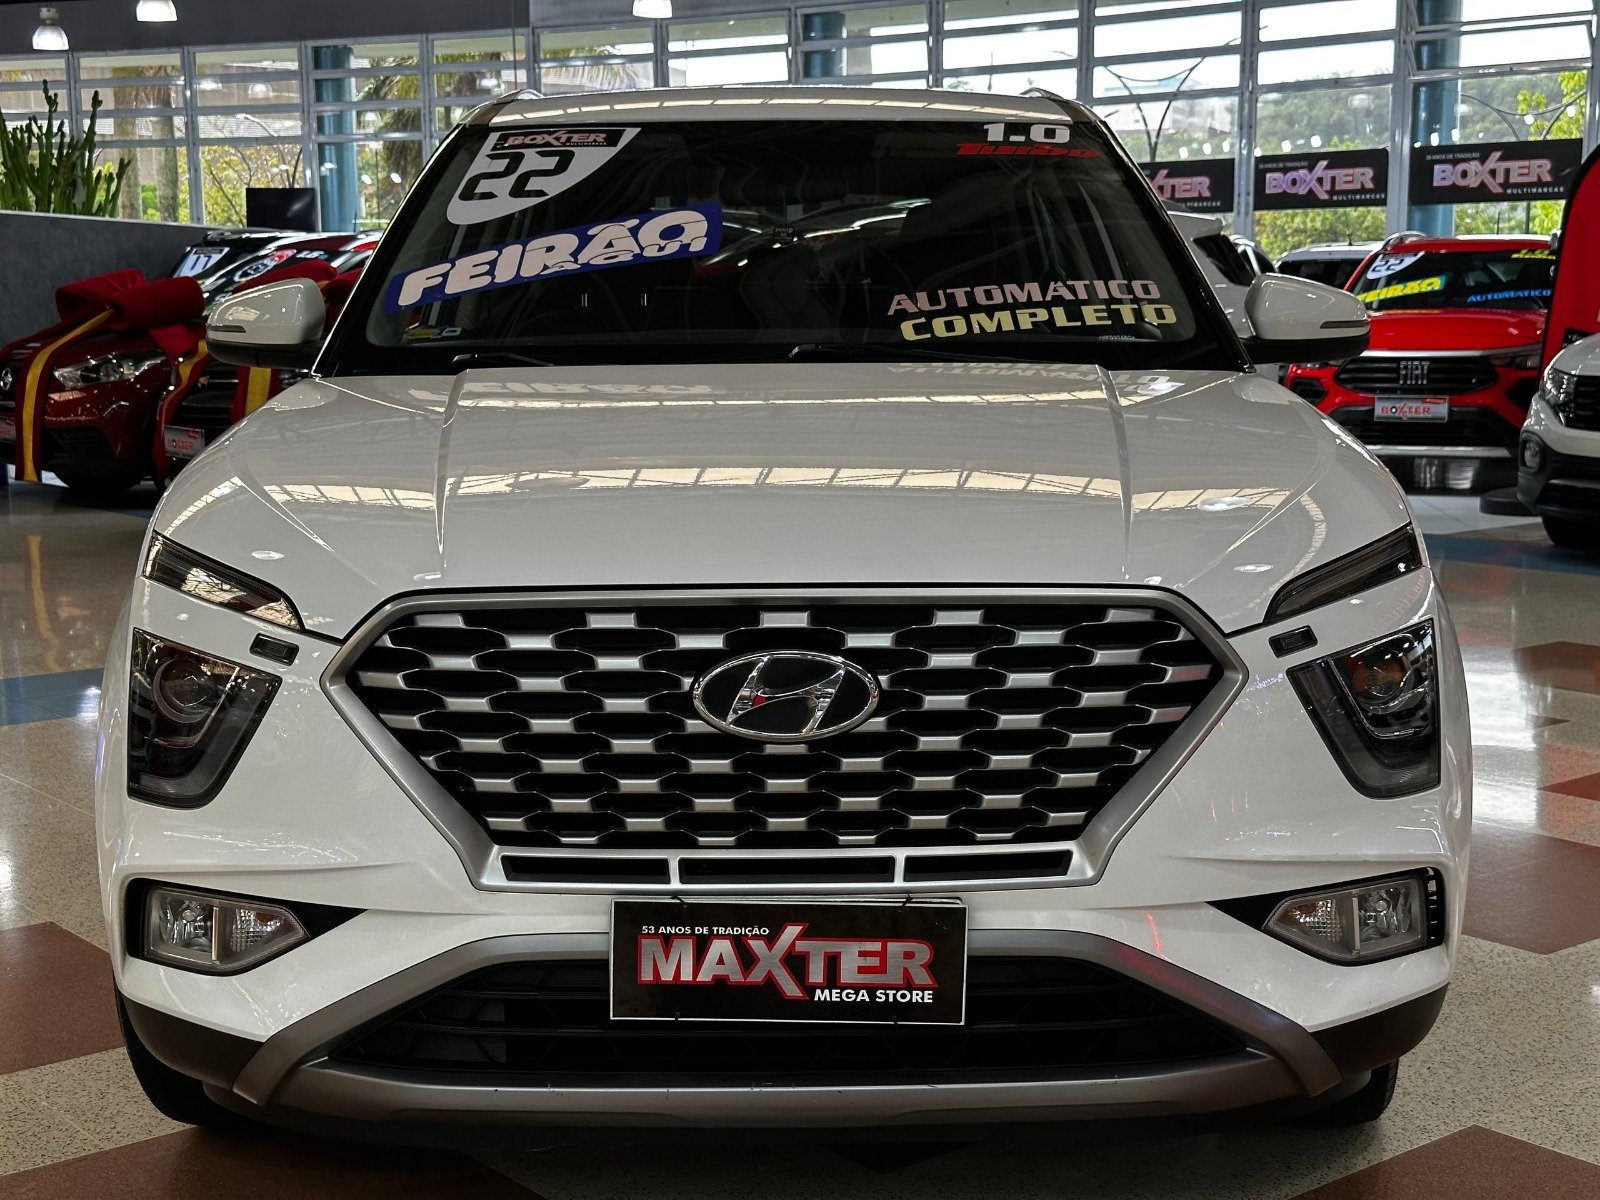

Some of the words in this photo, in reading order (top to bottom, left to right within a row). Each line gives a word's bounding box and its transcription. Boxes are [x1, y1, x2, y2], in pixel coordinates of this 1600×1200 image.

[506, 130, 608, 148] BOXTER
[983, 122, 1071, 143] 1.0
[458, 149, 576, 202] 22
[1264, 159, 1376, 200] BOXTER
[1432, 150, 1554, 194] BOXTER
[1332, 193, 1386, 201] MULTIMARCAS
[1506, 185, 1566, 195] MULTIMARCAS
[398, 210, 709, 307] FEIRÃO
[887, 279, 1161, 316] AUTOMÁTICO
[900, 303, 1178, 341] COMPLETO
[1399, 360, 1431, 385] FIAT
[1380, 400, 1433, 422] BOXTER
[641, 925, 656, 935] 53
[658, 925, 692, 935] ANOS
[694, 926, 710, 935] DE
[711, 924, 770, 938] TRADIÇÃO
[637, 922, 939, 1001] MAXTER
[813, 988, 871, 1003] MEGA
[875, 989, 934, 1004] STORE
